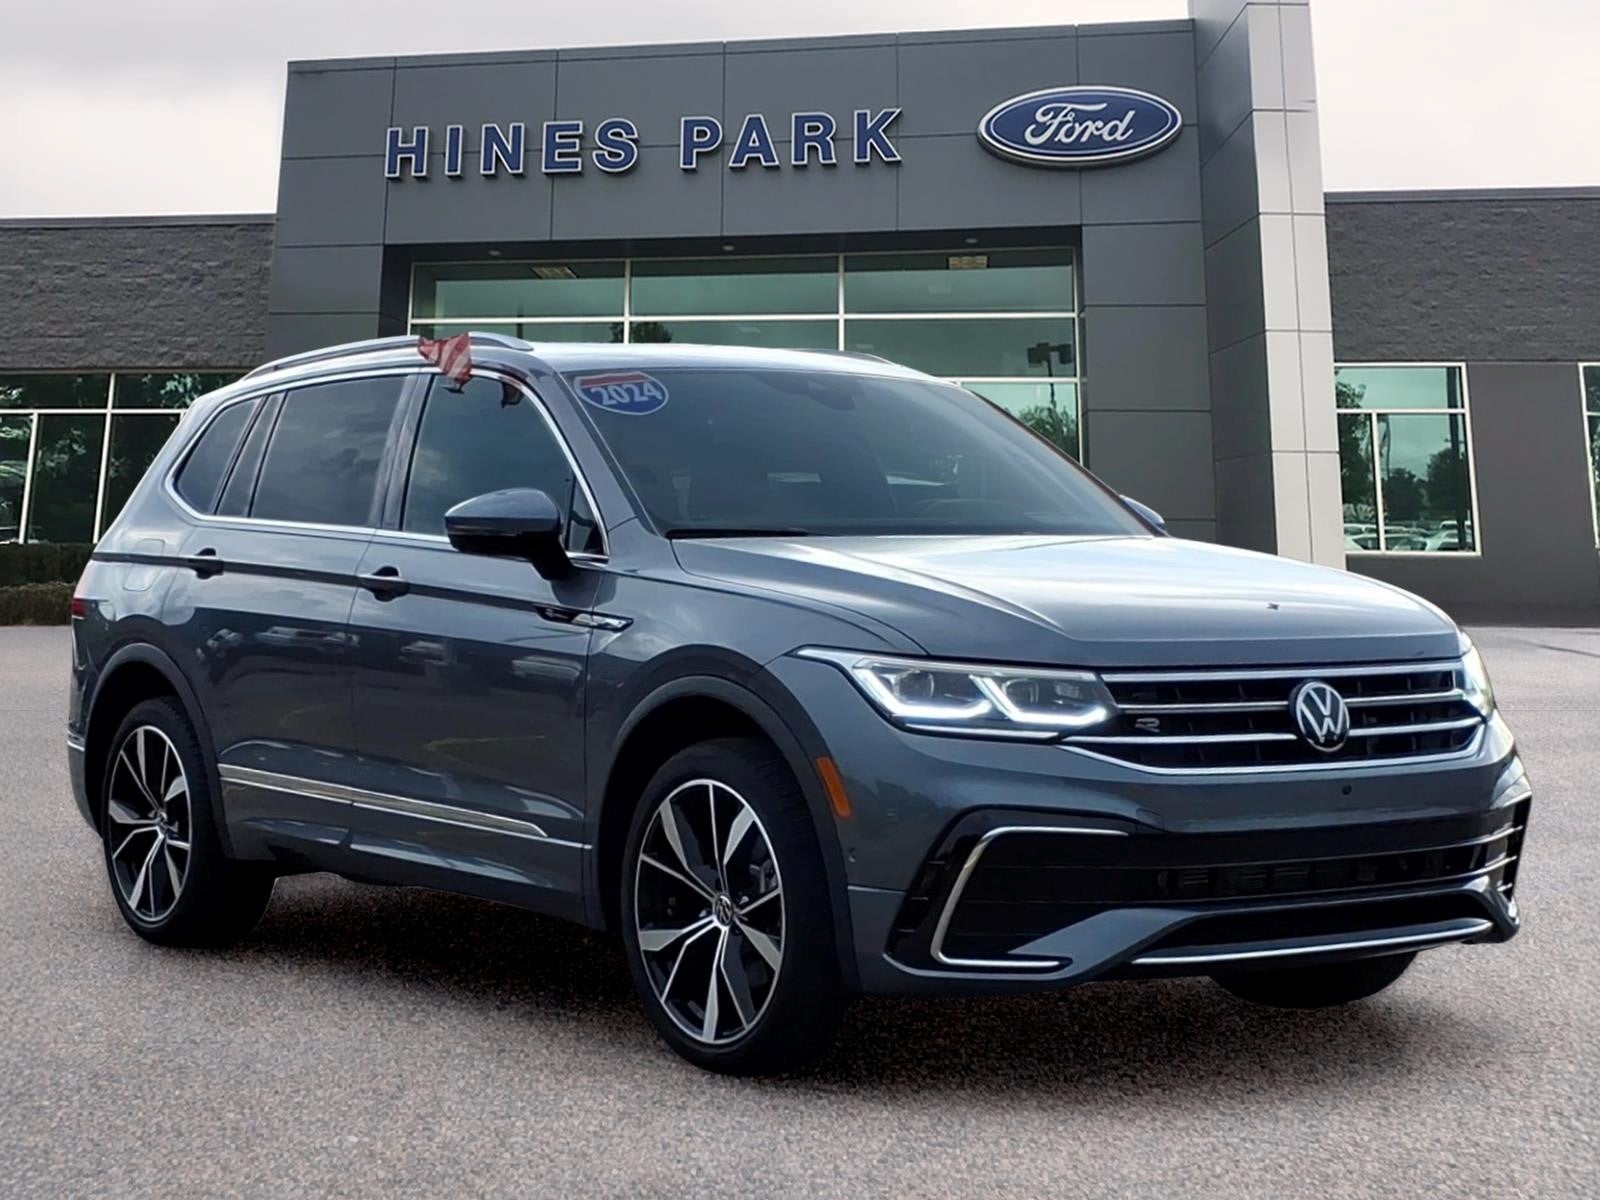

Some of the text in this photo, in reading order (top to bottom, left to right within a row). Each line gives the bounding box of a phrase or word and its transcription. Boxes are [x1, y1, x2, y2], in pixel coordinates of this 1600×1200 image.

[384, 108, 902, 177] HINES PARK
[1024, 102, 1136, 145] Ford
[590, 382, 663, 405] 2024
